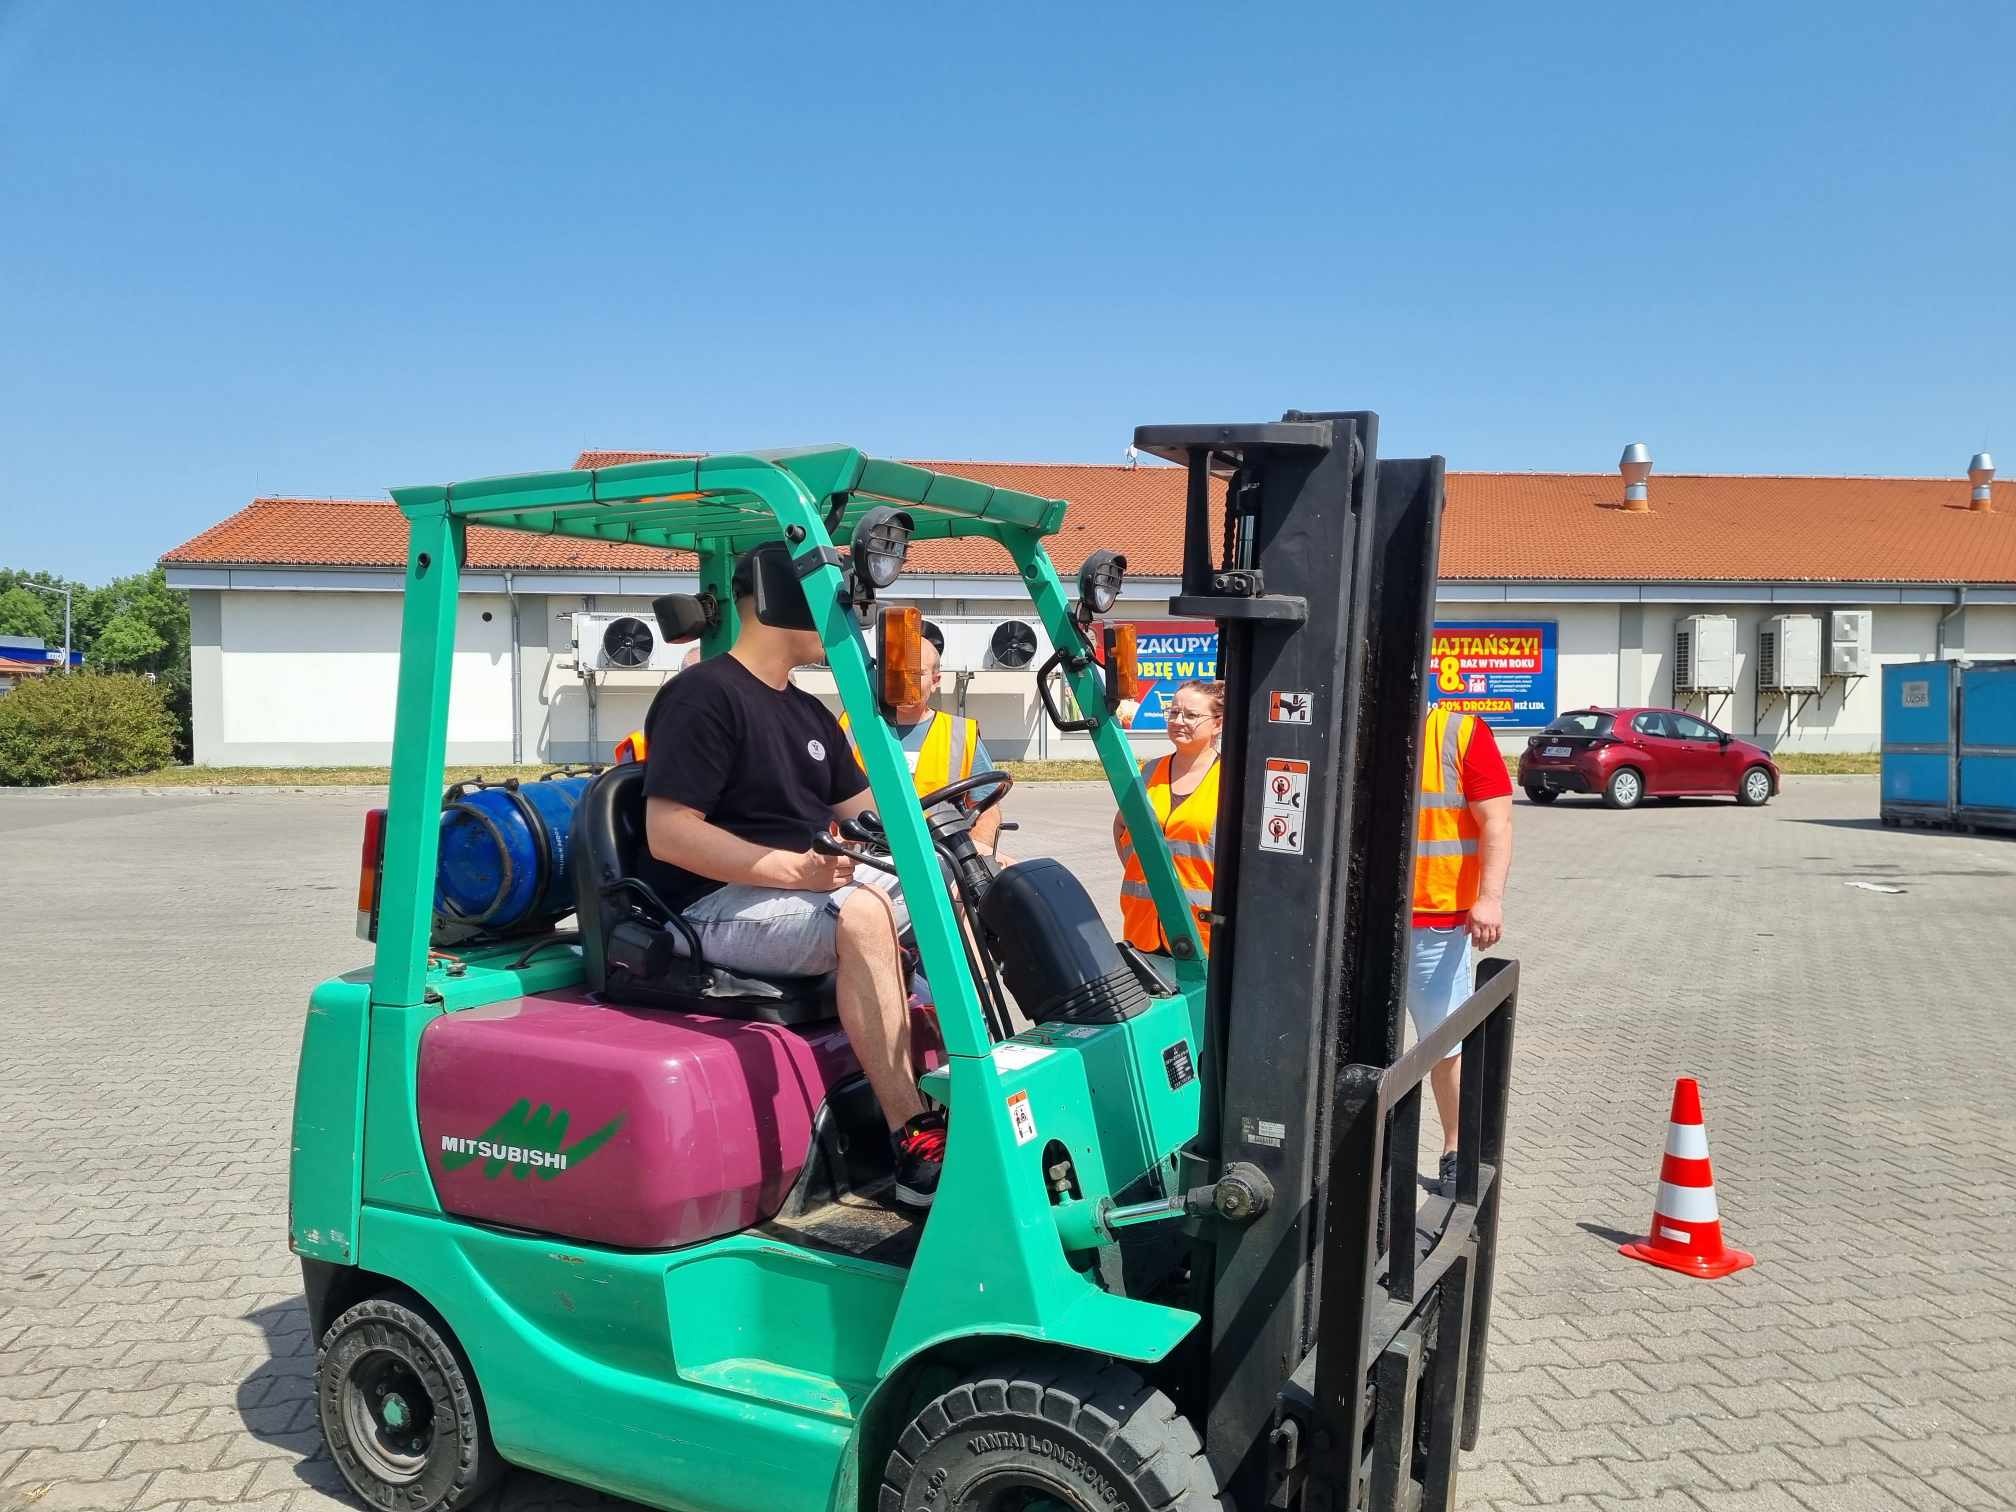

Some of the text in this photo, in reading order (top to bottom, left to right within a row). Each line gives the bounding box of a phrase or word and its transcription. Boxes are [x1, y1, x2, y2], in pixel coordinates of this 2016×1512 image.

[1136, 637, 1212, 654] ZAKUPY
[1176, 662, 1195, 677] W
[1461, 659, 1535, 669] RAZ W TYM ROKU
[1463, 699, 1512, 711] DROŻSZA
[441, 1135, 567, 1170] MITSUBISHI
[967, 1431, 1026, 1456] YANTAI
